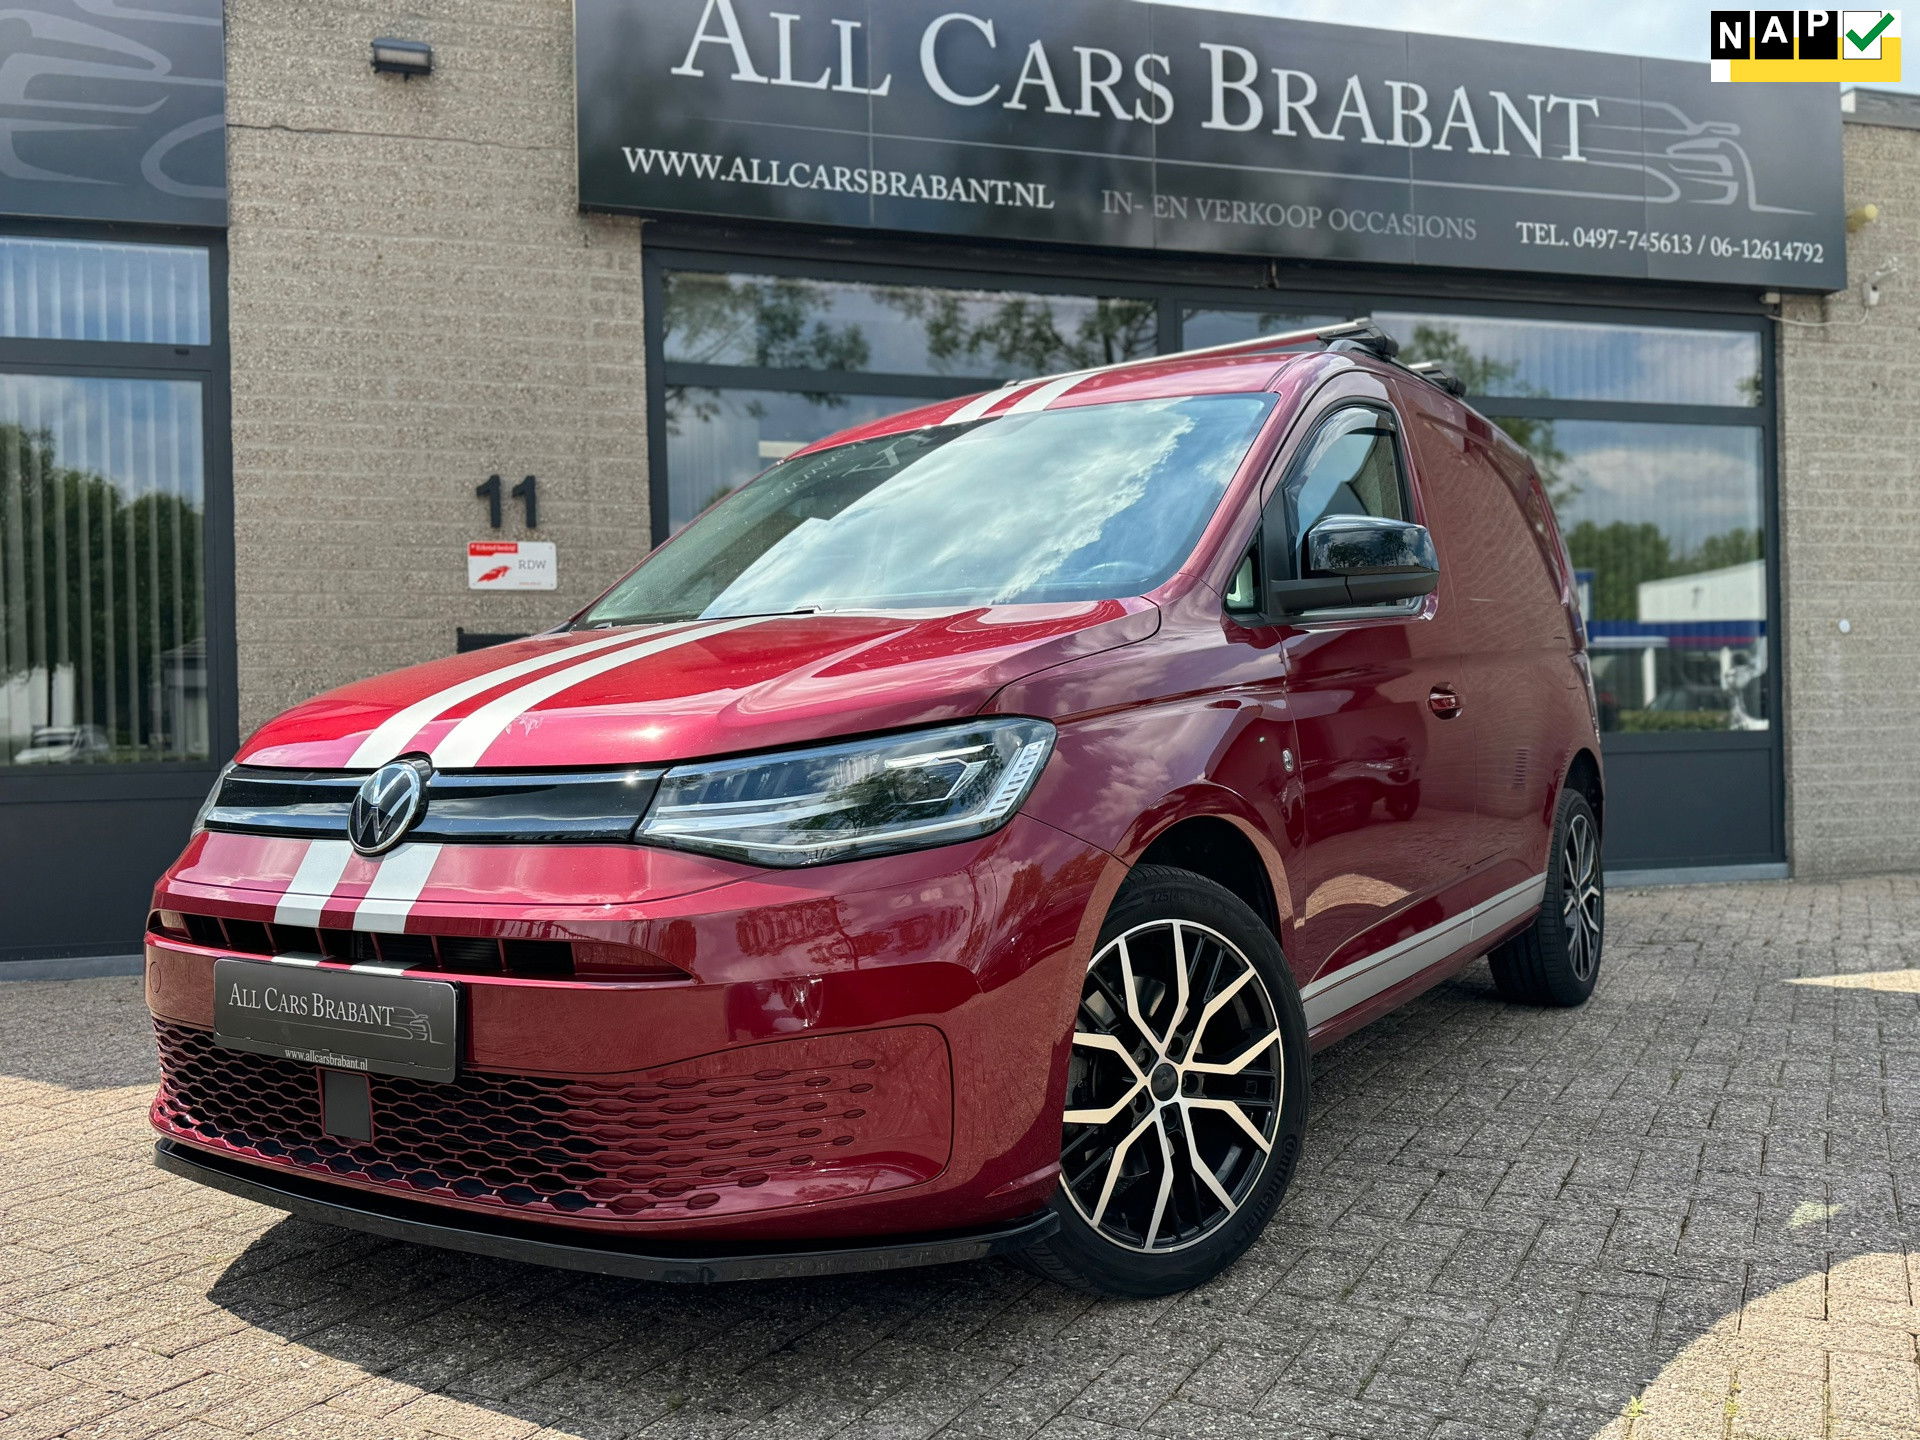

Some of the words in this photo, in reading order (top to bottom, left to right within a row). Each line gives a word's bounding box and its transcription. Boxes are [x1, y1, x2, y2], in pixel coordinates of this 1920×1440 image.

[671, 0, 891, 96] ALL
[920, 13, 1174, 125] CARS
[1200, 42, 1600, 162] BRABANT
[1101, 190, 1143, 215] IN-
[1153, 195, 1188, 219] EN
[1195, 198, 1322, 229] VERKOOP
[1329, 208, 1477, 240] OCCASIONS
[1516, 222, 1569, 246] TEL.
[1573, 227, 1692, 254] 0497-745613
[1710, 236, 1824, 263] 06-12614792
[476, 474, 537, 529] 11
[518, 560, 546, 570] RDW
[228, 982, 261, 1010] ALL
[264, 987, 308, 1016] CARS
[312, 992, 395, 1027] BRABANT
[284, 1048, 369, 1072] www.allcarsbrabant.nl
